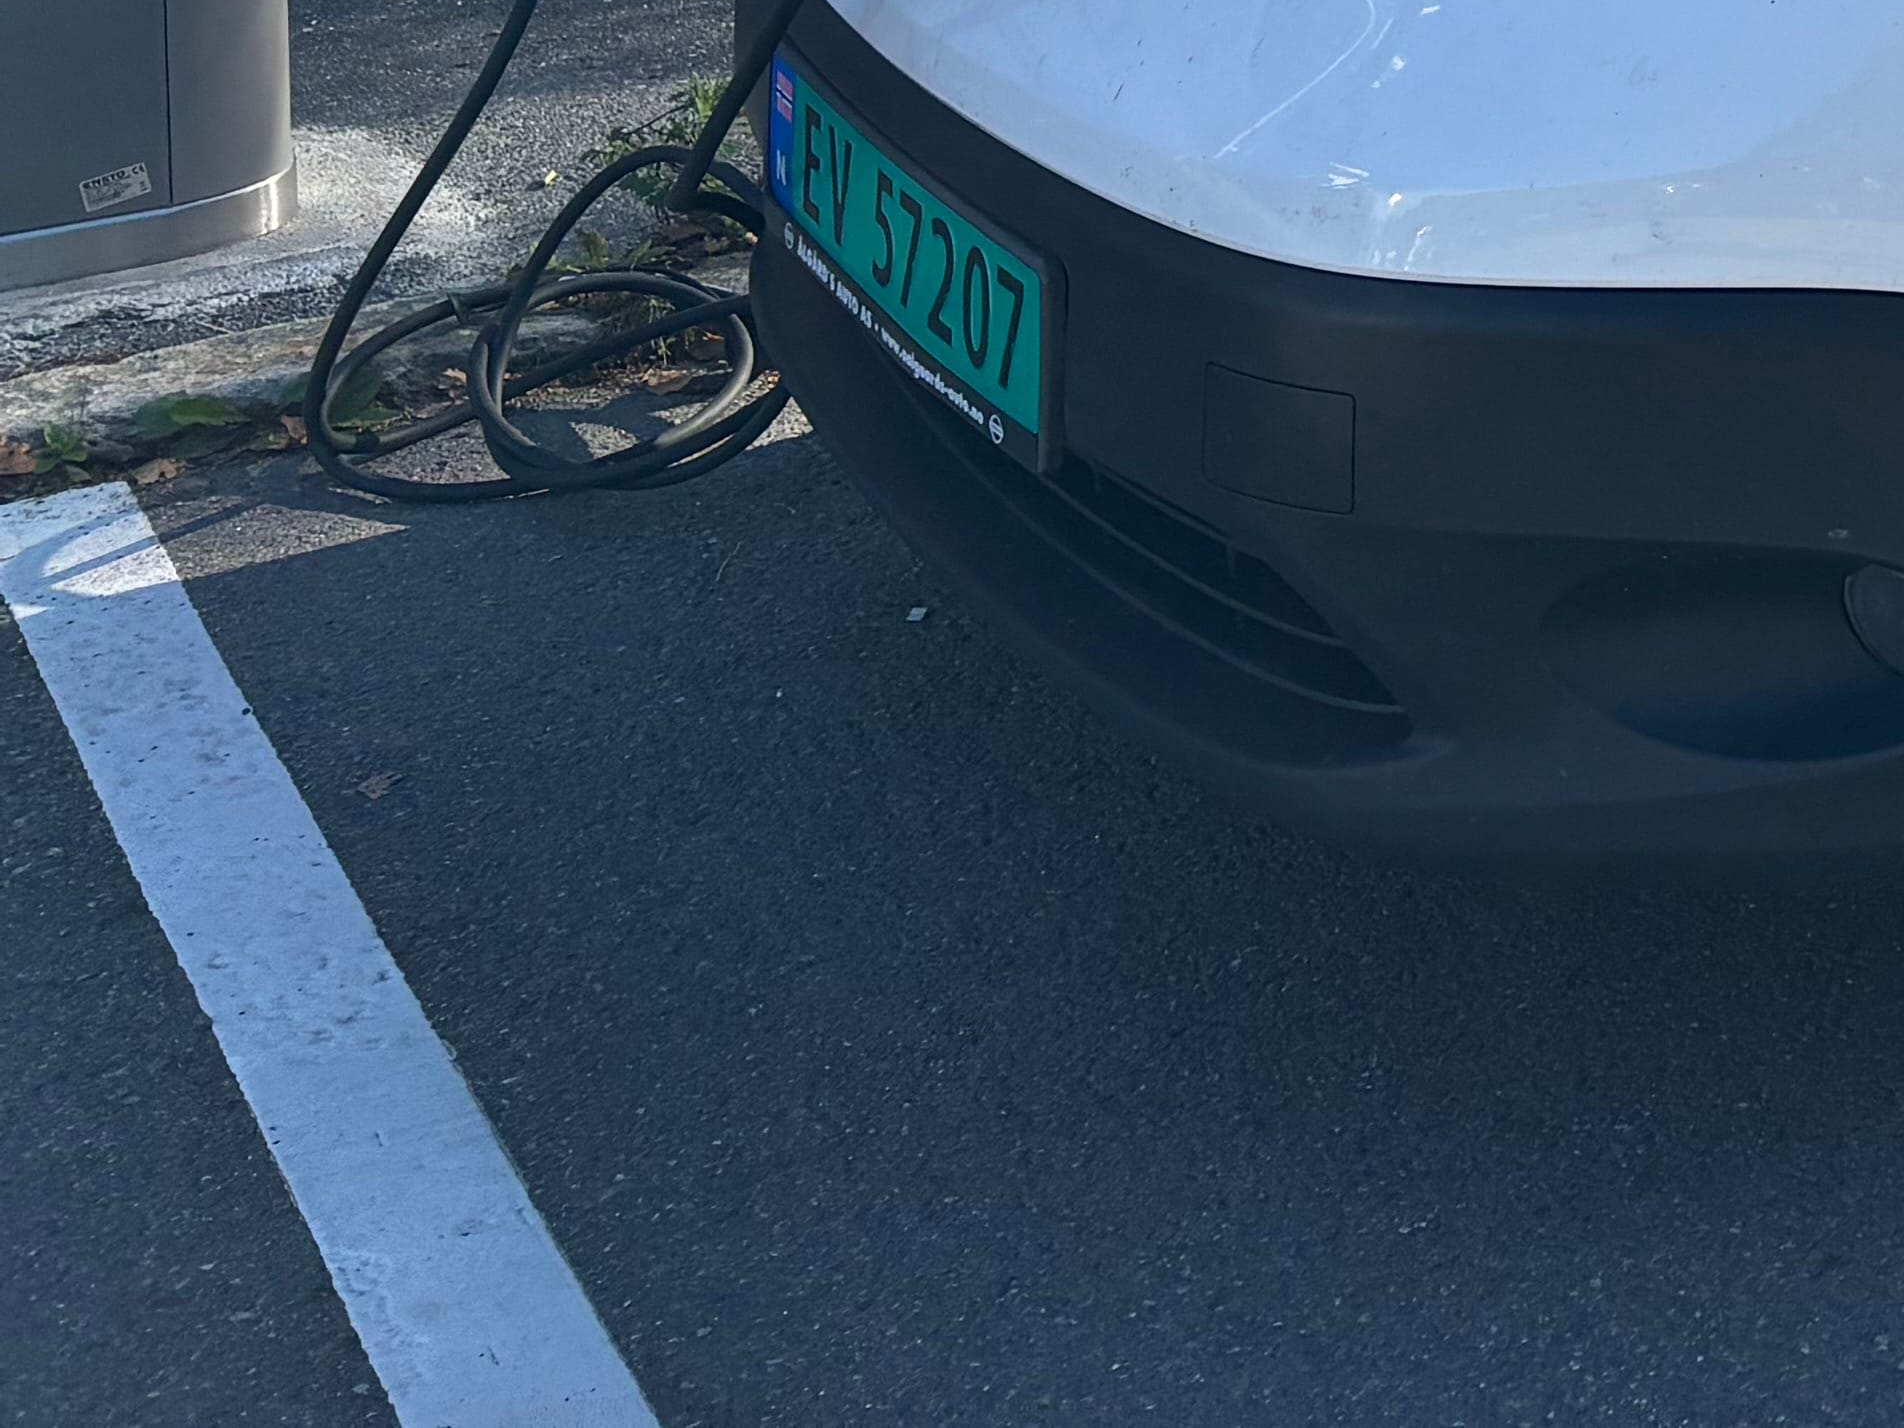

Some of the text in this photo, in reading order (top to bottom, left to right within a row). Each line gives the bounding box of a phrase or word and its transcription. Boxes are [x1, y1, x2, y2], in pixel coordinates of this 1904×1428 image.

[776, 148, 787, 186] N
[802, 105, 1025, 390] EV 57207
